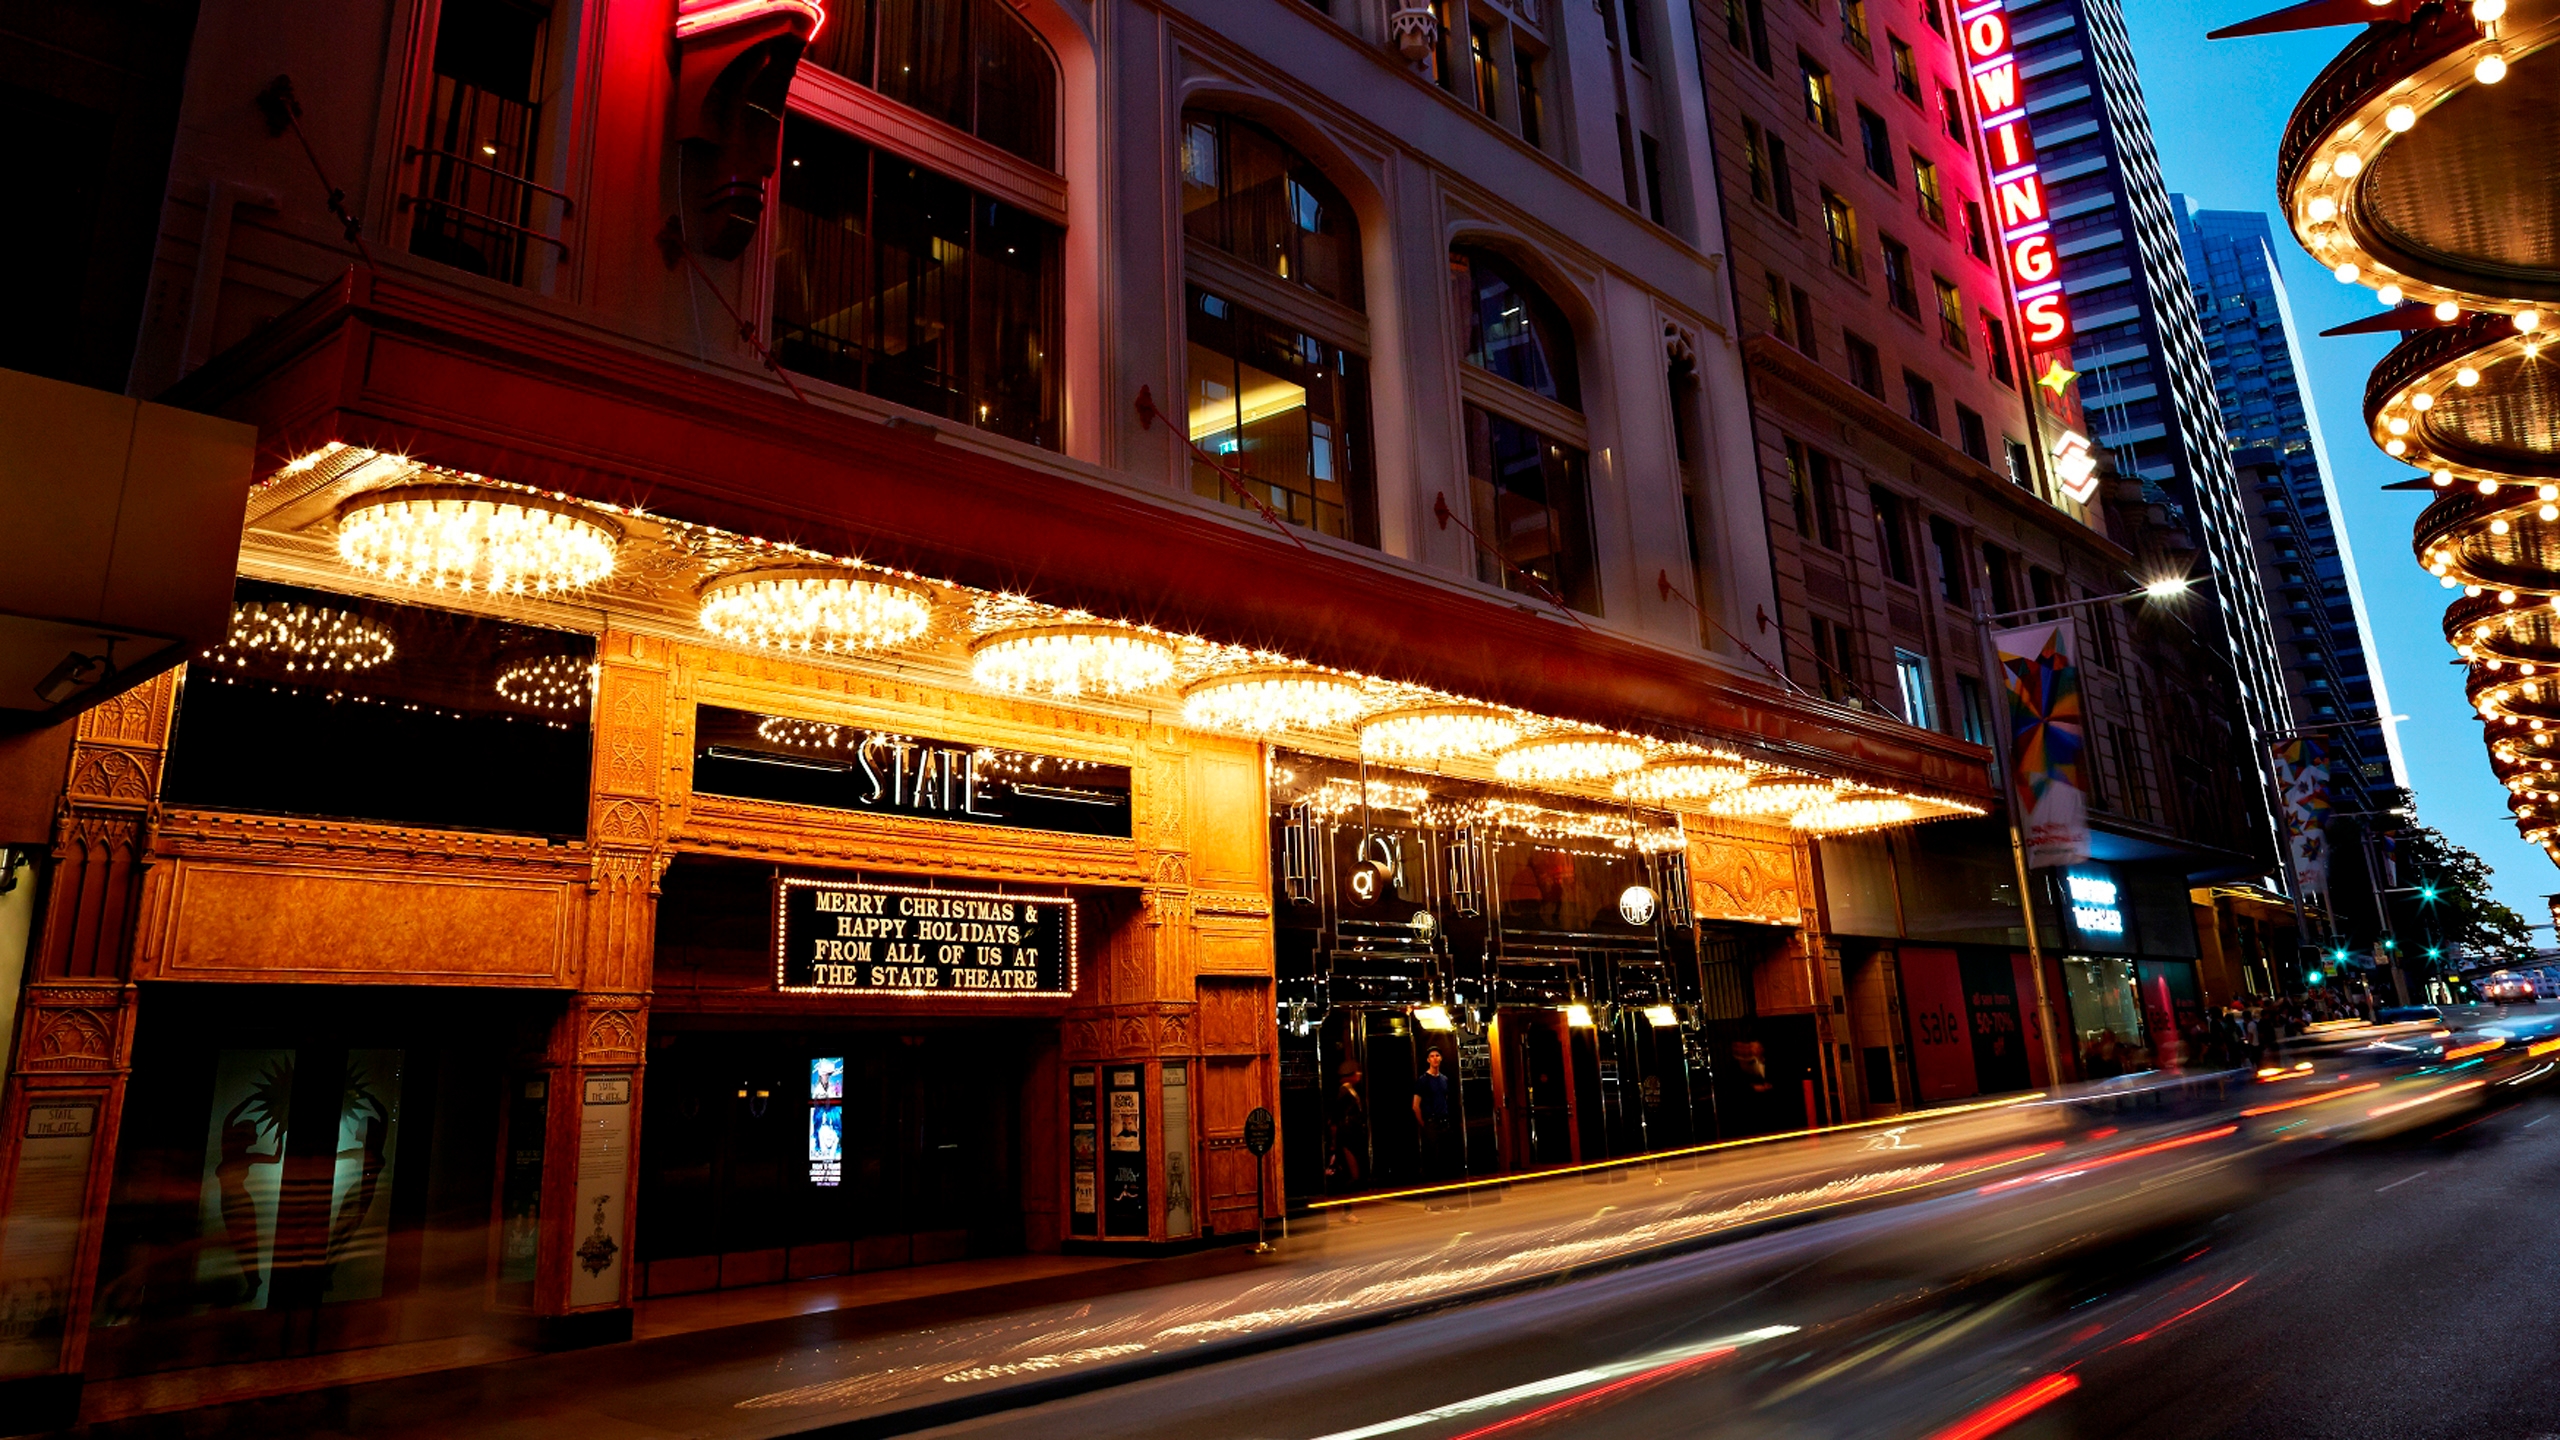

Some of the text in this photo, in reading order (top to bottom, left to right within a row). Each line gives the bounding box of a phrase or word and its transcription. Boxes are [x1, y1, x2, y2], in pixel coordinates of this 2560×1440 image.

[1960, 0, 2065, 342] OWINGS
[857, 737, 1004, 818] STATE
[815, 891, 1038, 923] MERRY CHRISTMAS &
[837, 916, 1020, 944] HAPPY HOLIDAYS
[815, 940, 1038, 967] FROM ALL OF US AT
[814, 964, 1038, 989] THE STATE THEATRE
[1920, 1003, 1959, 1044] sale
